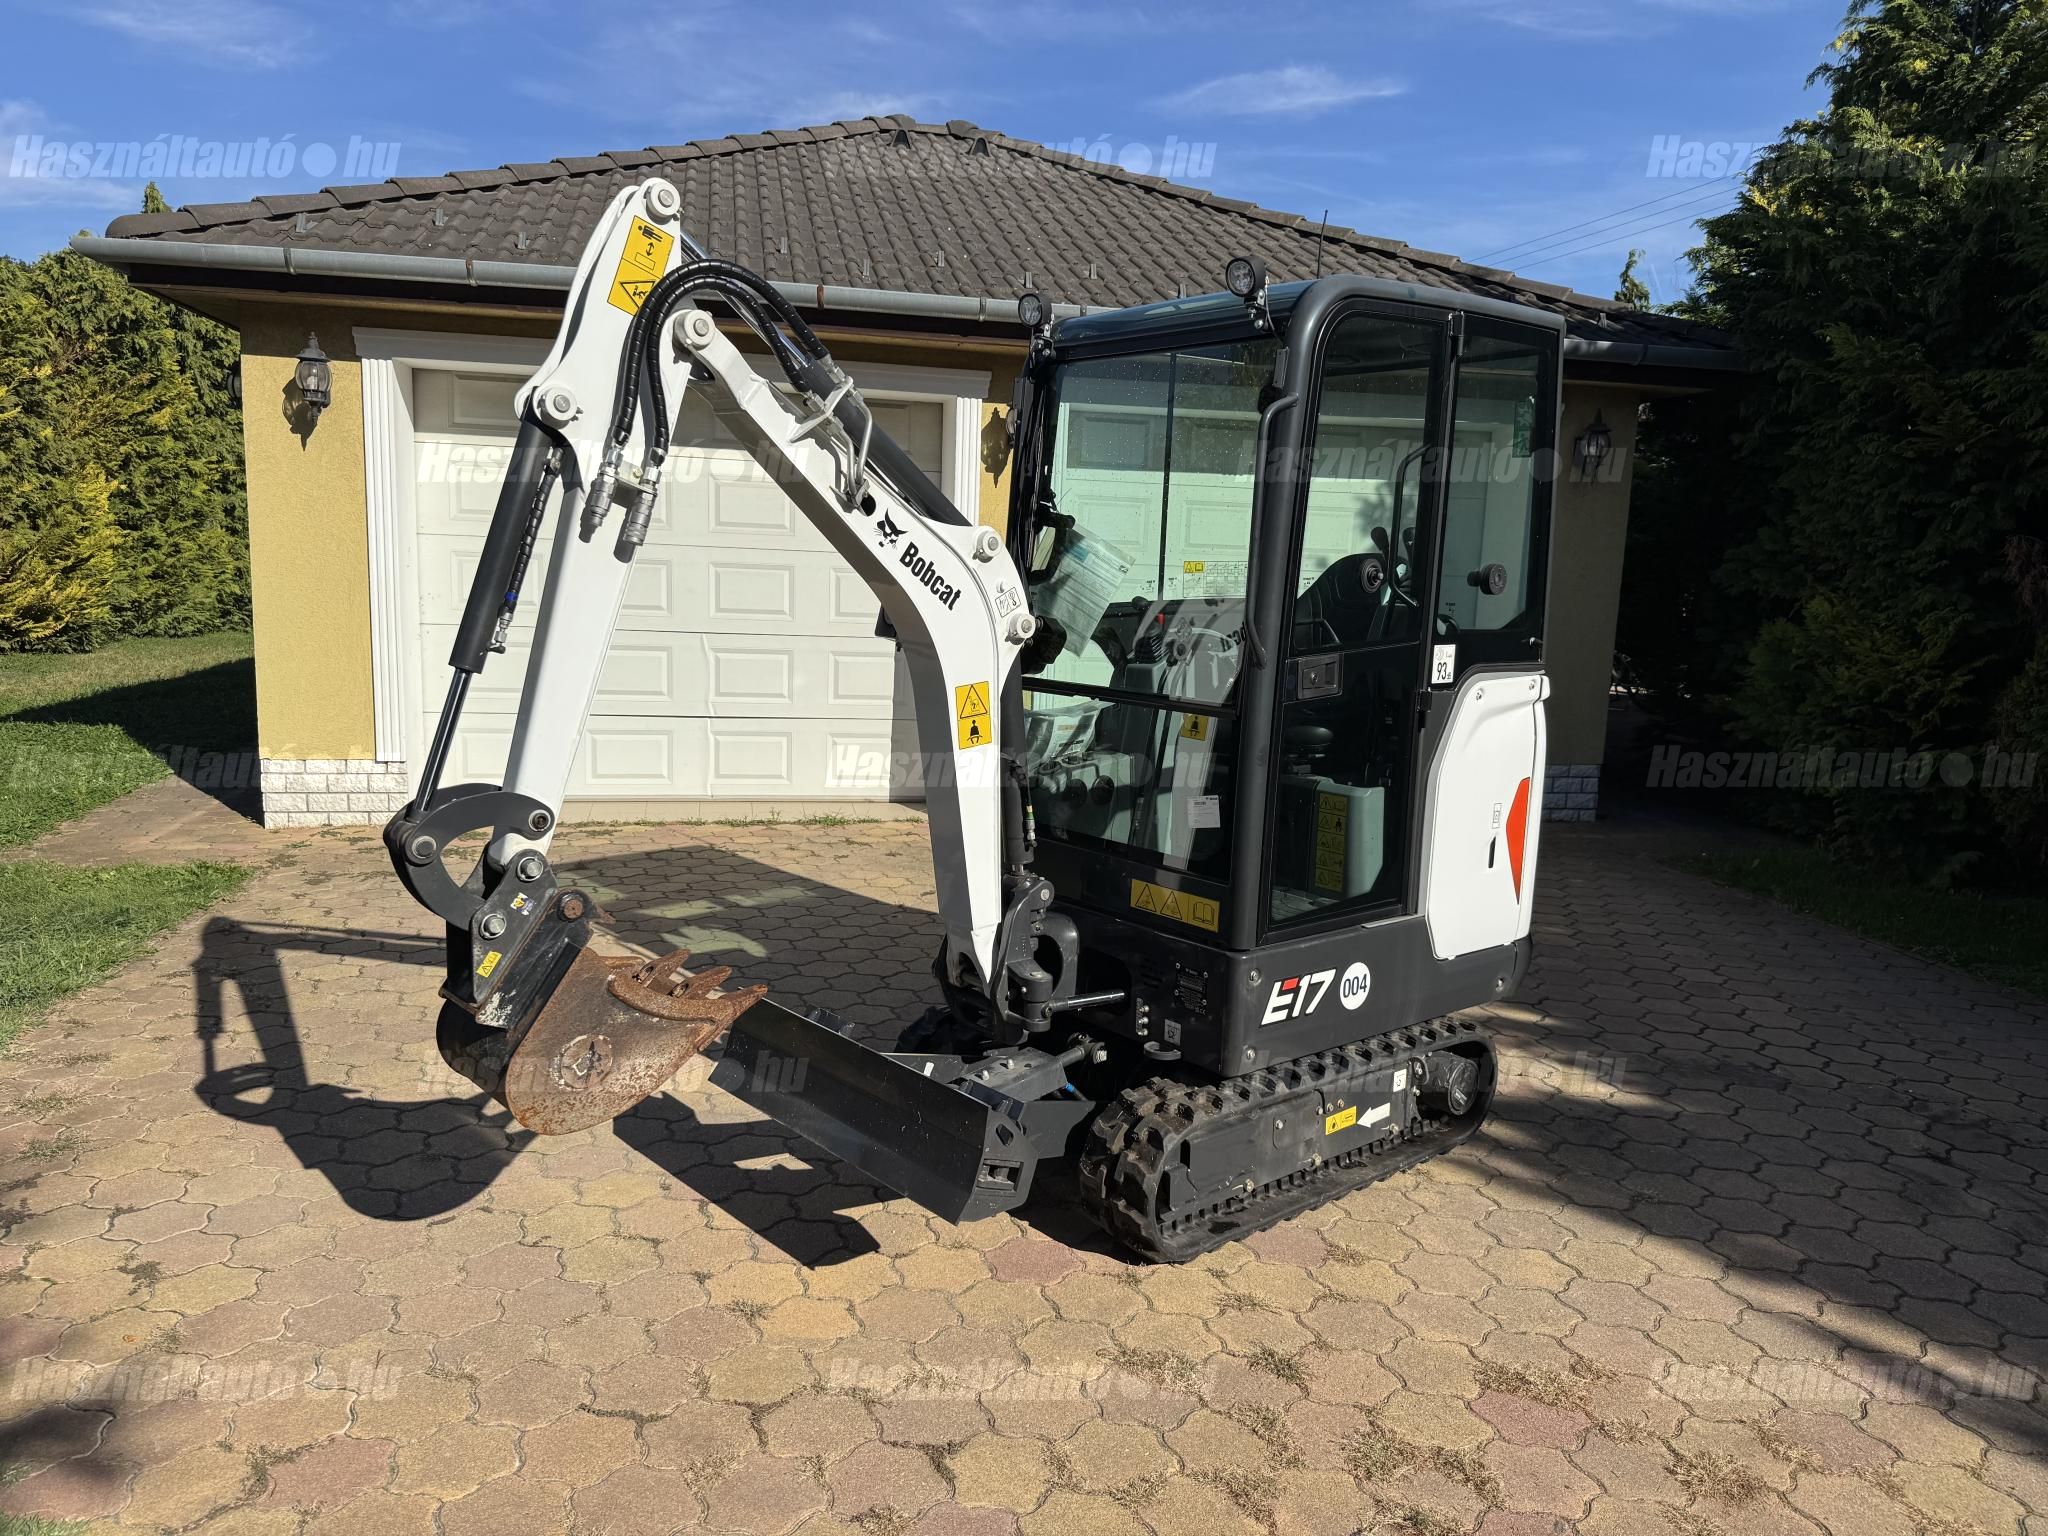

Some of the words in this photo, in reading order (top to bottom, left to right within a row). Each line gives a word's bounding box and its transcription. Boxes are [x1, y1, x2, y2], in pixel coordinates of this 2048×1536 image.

[899, 541, 962, 611] Bobcat
[1437, 662, 1448, 680] 93
[1260, 968, 1337, 1026] E17
[1343, 974, 1368, 999] 004
